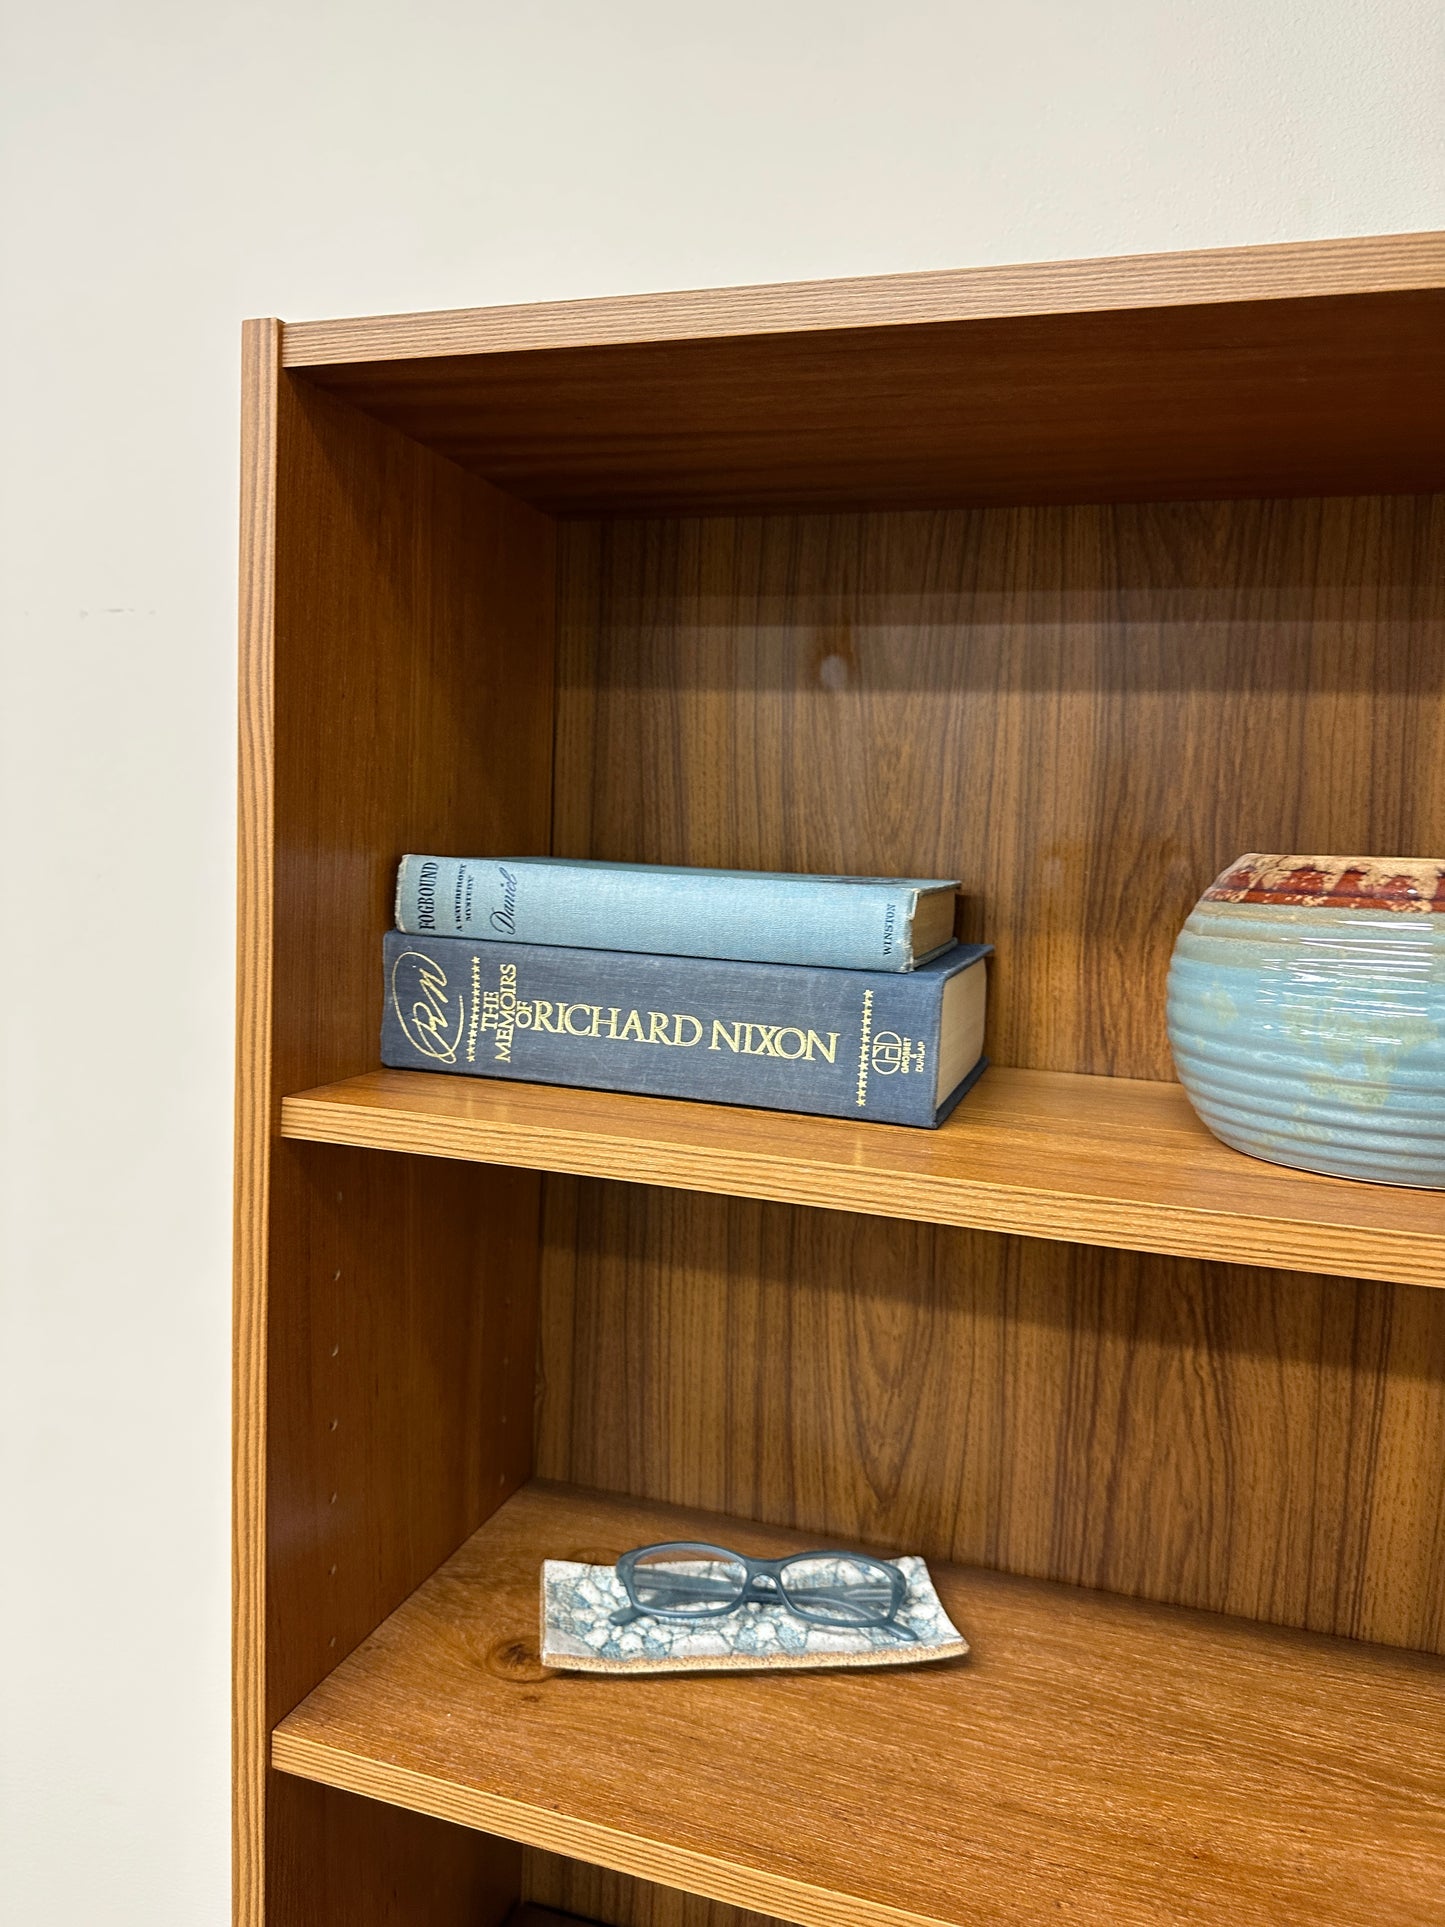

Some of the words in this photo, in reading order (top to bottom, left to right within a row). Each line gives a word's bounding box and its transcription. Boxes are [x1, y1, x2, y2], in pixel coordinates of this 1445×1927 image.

[417, 861, 439, 931] FOGBOUND
[455, 863, 467, 923] WATERFRONT
[465, 875, 474, 921] MYSTERY
[489, 867, 517, 935] Daniel
[883, 903, 896, 956] WINSTON
[481, 991, 500, 1032] THE
[494, 963, 517, 1063] MEMOIRS
[515, 1000, 533, 1028] OF
[532, 999, 703, 1048] RICHARD
[709, 1019, 841, 1064] NIXON
[915, 1041, 925, 1073] DUNLAP
